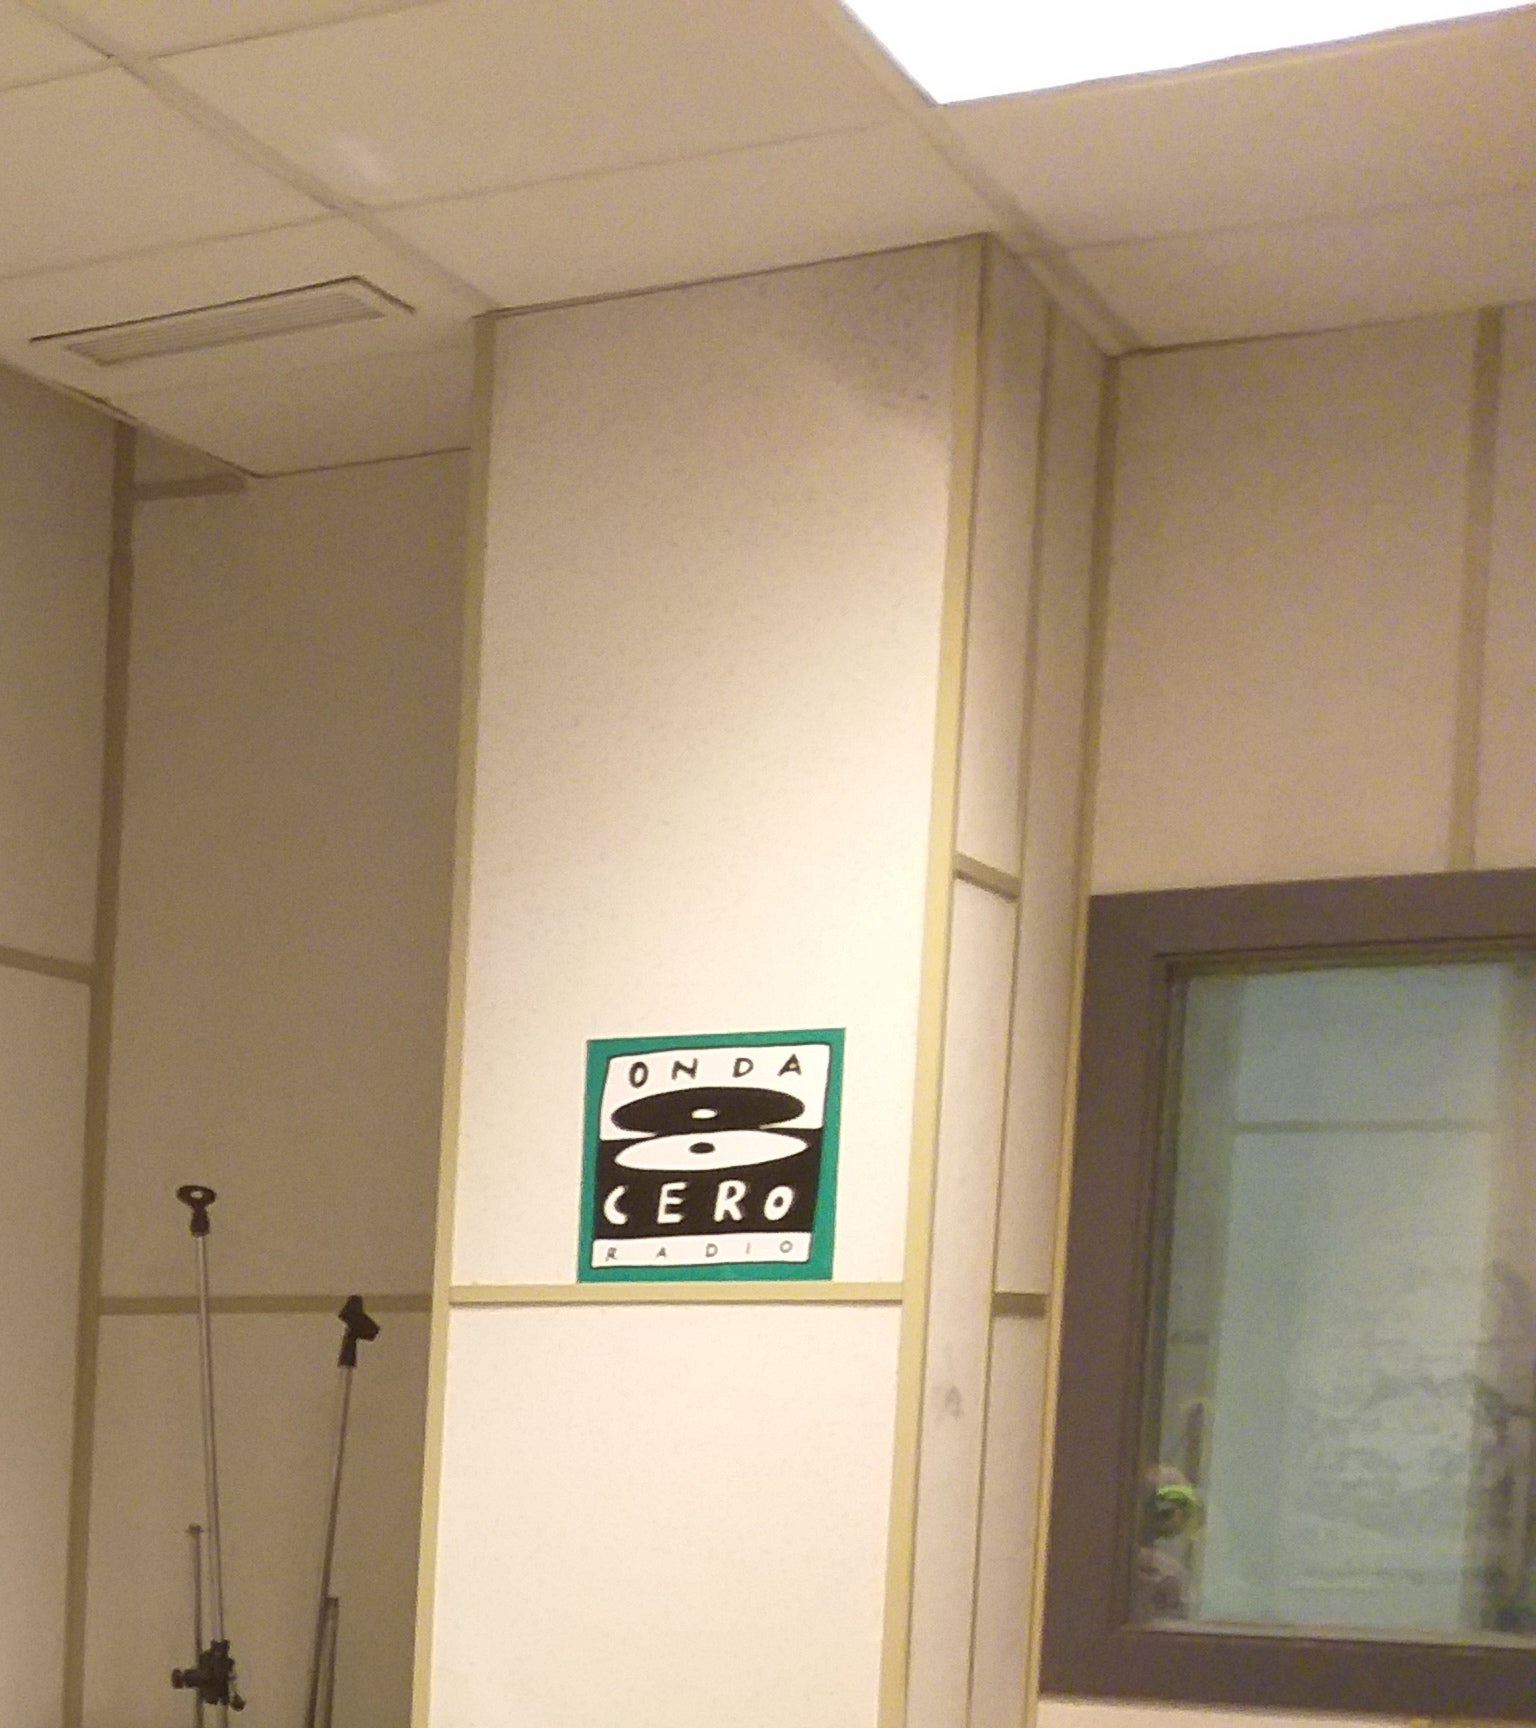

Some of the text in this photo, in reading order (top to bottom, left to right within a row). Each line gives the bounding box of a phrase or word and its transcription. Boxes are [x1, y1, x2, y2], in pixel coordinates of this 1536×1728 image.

[628, 1053, 802, 1088] ONDA
[603, 1180, 796, 1225] CERO
[605, 1240, 794, 1262] RADIO
